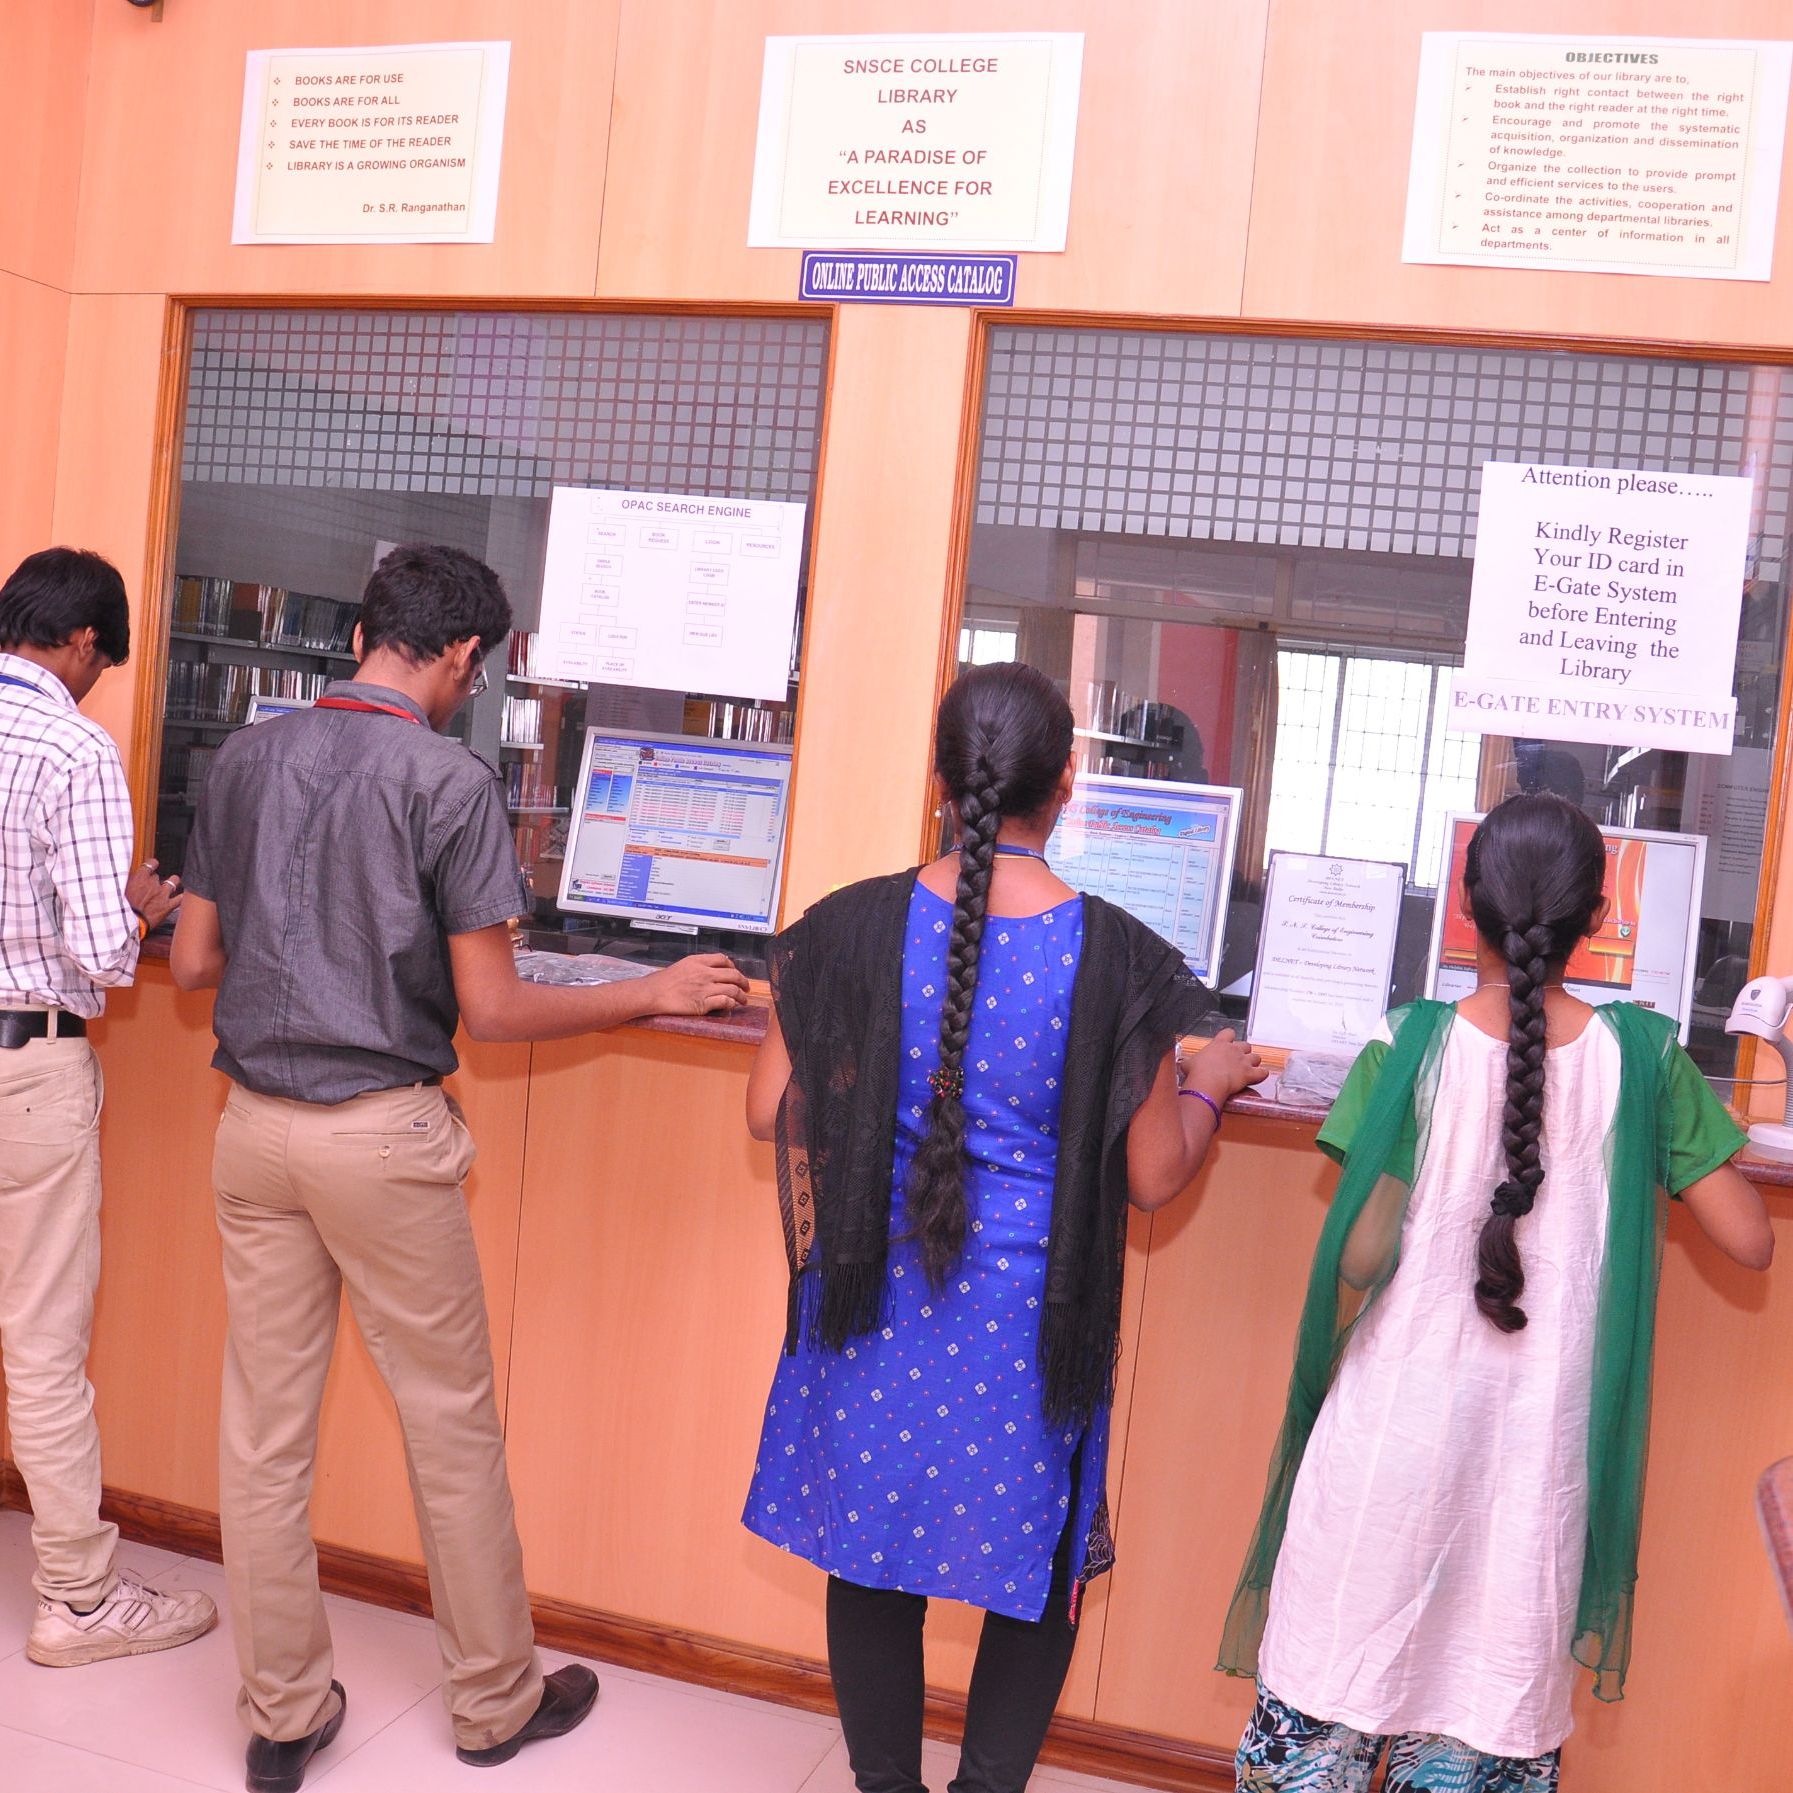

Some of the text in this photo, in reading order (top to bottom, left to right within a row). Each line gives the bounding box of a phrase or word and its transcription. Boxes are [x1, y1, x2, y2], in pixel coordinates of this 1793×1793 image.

[844, 58, 998, 73] SNSCE COLLEGE
[1565, 51, 1659, 64] OBJECTIVES
[295, 74, 404, 86] BOOKS ARE FOR USE
[1467, 67, 1689, 85] The main objectives of our library are to,
[293, 96, 400, 107] BOOKS ARE FOR ALL
[878, 89, 958, 103] LIBRARY
[1496, 85, 1744, 104] Establish right contact between the right
[1494, 99, 1729, 118] book and the right reader at the right time.
[291, 115, 459, 128] EVERY BOOK IS FOR ITS READER
[902, 120, 926, 133] AS
[1493, 116, 1740, 135] Encourage and promote the systematic
[289, 137, 452, 149] SAVE THE TIME OF THE READER
[1491, 131, 1739, 149] acquisition, organization and dissemination
[865, 150, 956, 164] PARADISE
[962, 150, 987, 164] OF
[1489, 145, 1565, 159] of knowledge.
[287, 158, 466, 171] LIBRARY IS A GROWING ORGANISM
[1488, 161, 1736, 182] Organize the collection to provide prompt
[828, 181, 992, 195] EXCELLENCE FOR
[1486, 176, 1677, 193] and efficient services to the users.
[362, 202, 466, 214] Dr. S.R. Ranganathan
[1485, 192, 1732, 213] Co-ordinate the activities, cooperation and
[1484, 207, 1713, 227] assistance among departmental libraries.
[1482, 223, 1729, 245] Act as a center of information in all
[1481, 238, 1552, 251] departments.
[812, 262, 1003, 294] ONLINE PUBLIC ACCESS CATALOG
[1521, 467, 1610, 489] Attention
[622, 499, 751, 518] OPAC SEARCH ENGINE
[1535, 521, 1688, 550] Kindly Register
[1533, 548, 1684, 577] Your ID card in
[1534, 575, 1677, 604] E-Gate System
[1528, 601, 1677, 635] before Entering
[1519, 630, 1679, 659] and Leaving the
[1560, 659, 1632, 685] Library
[1454, 691, 1729, 729] E-GATE ENTRY SYSTEM
[1111, 808, 1122, 820] of
[1122, 809, 1172, 824] Engineering
[1288, 895, 1375, 912] Certificate of Membership
